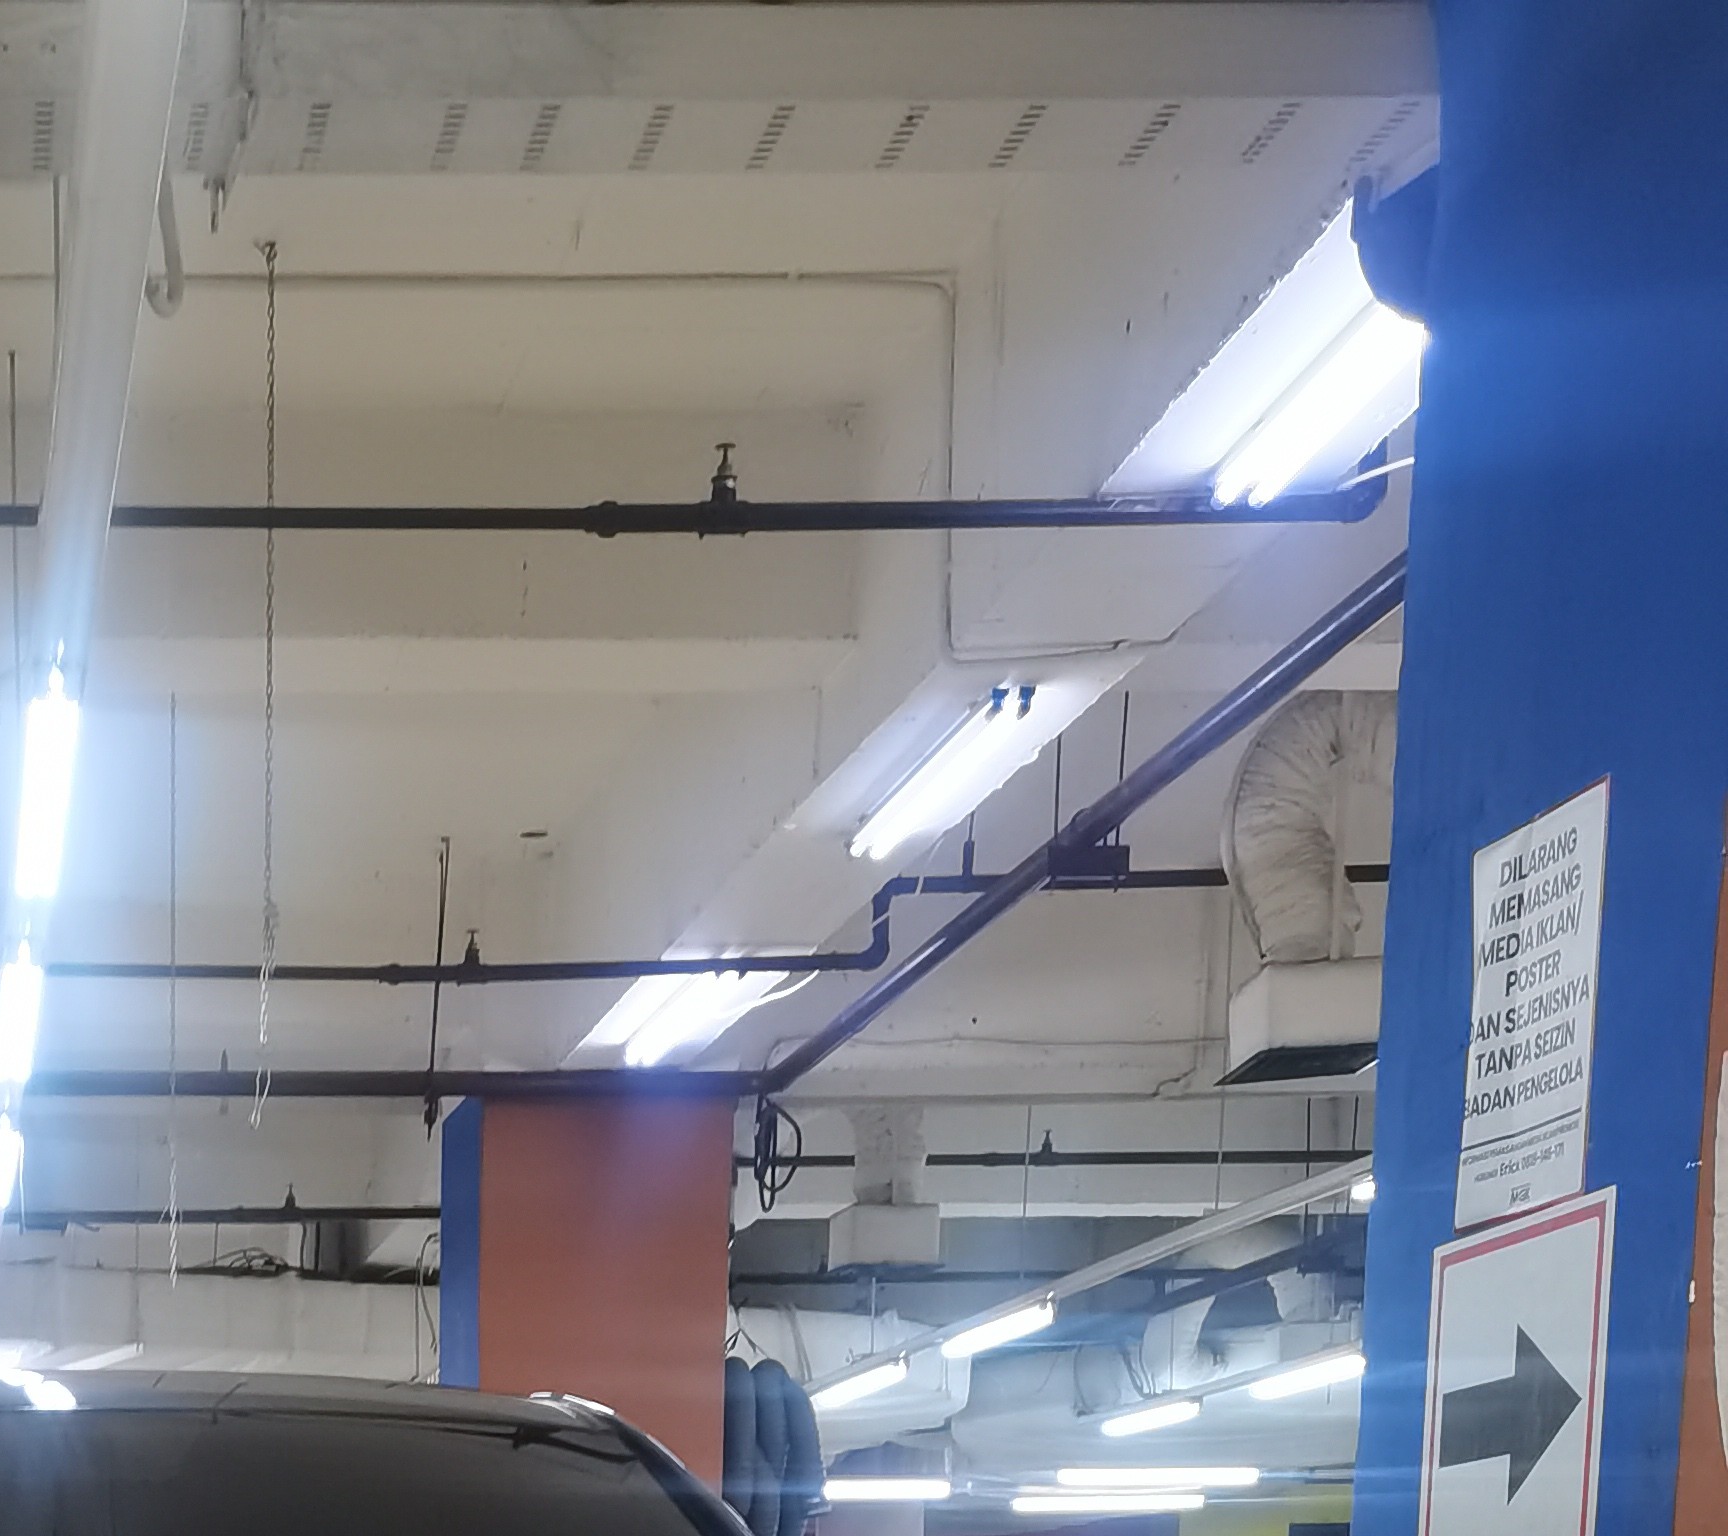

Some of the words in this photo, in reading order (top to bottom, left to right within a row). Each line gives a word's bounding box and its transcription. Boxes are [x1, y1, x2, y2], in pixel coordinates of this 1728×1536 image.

[1499, 826, 1578, 888] DILARANG
[1489, 862, 1582, 929] MEMASANG
[1478, 925, 1535, 969] MEDIA
[1536, 889, 1584, 948] IKLAN/
[1503, 973, 1590, 1034] SEJENISNYA
[1505, 949, 1562, 997] POSTER
[1474, 1037, 1533, 1080] TANPA
[1533, 1016, 1576, 1061] SEIZIN
[1516, 1055, 1584, 1105] PENGELOLA
